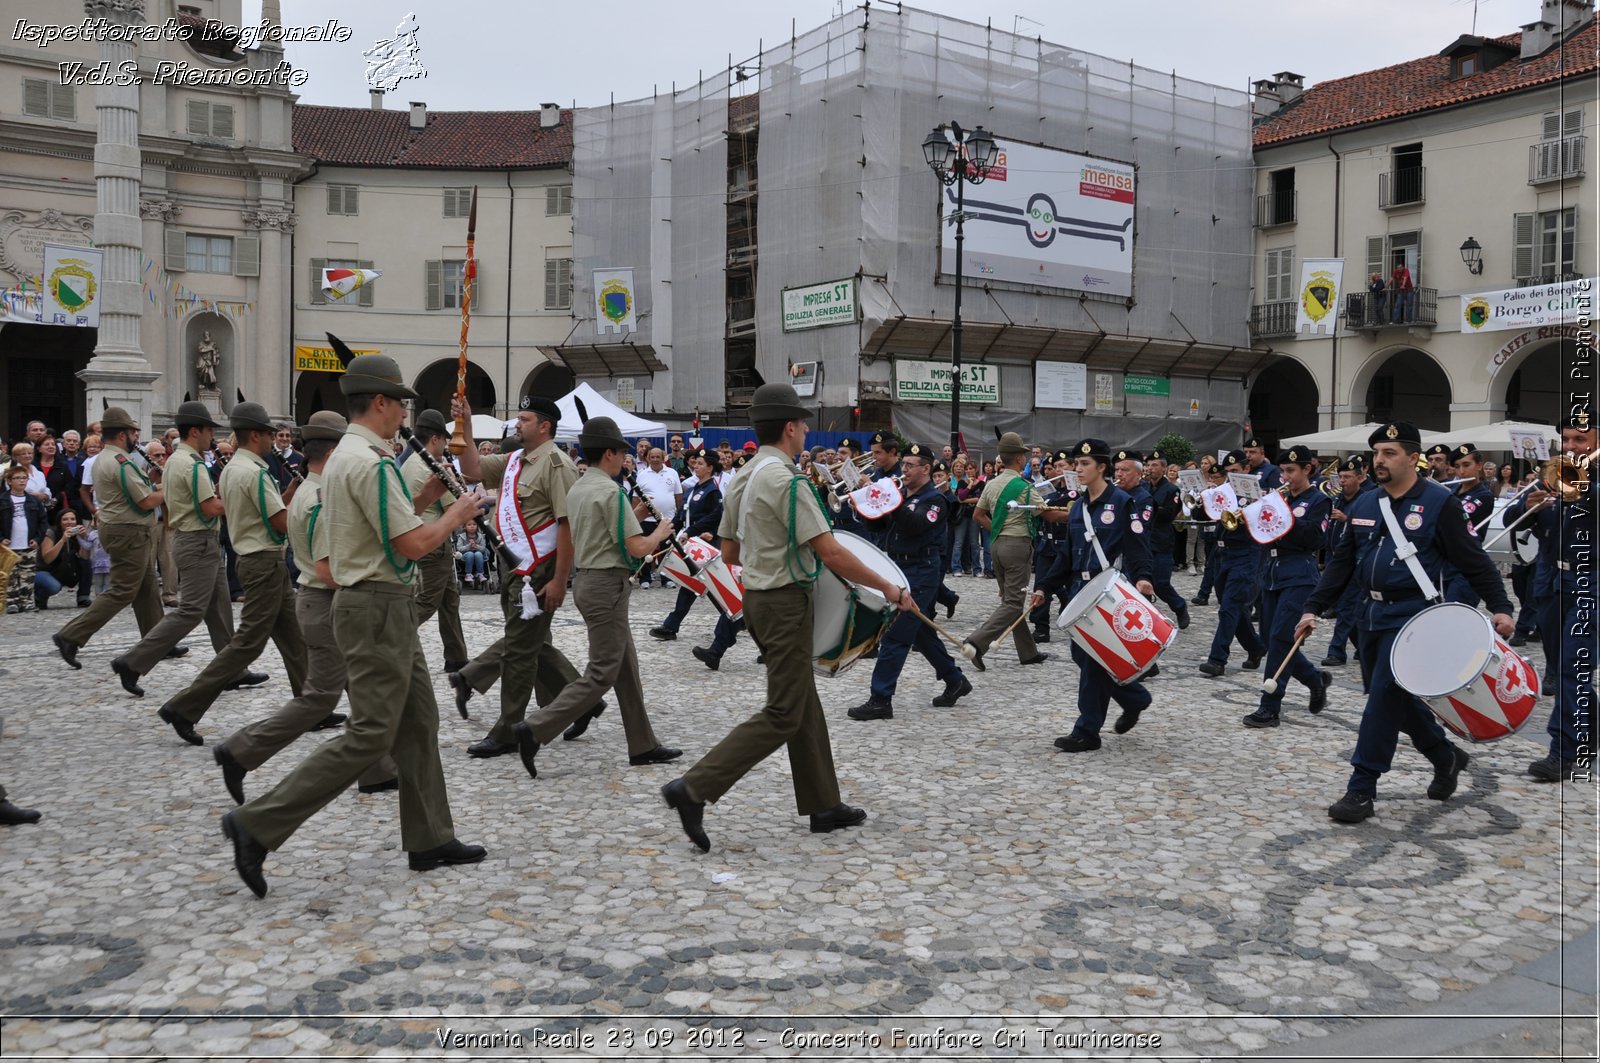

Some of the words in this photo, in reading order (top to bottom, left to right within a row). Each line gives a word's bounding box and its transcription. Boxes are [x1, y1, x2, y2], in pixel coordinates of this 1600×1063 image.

[1085, 169, 1132, 190] mensa
[803, 291, 831, 306] IMPRESA
[834, 283, 848, 301] ST
[1503, 291, 1525, 302] Palio
[1530, 289, 1543, 299] dei
[1547, 283, 1582, 297] Borgh
[786, 311, 813, 321] EDILIZIA
[815, 305, 852, 316] GENERALE
[1494, 304, 1542, 318] Borgo
[298, 357, 347, 371] BENEFIC
[930, 369, 967, 381] IMPRA
[970, 366, 987, 381] ST
[899, 381, 940, 391] EDILIZIA
[504, 506, 519, 543] CARITAS
